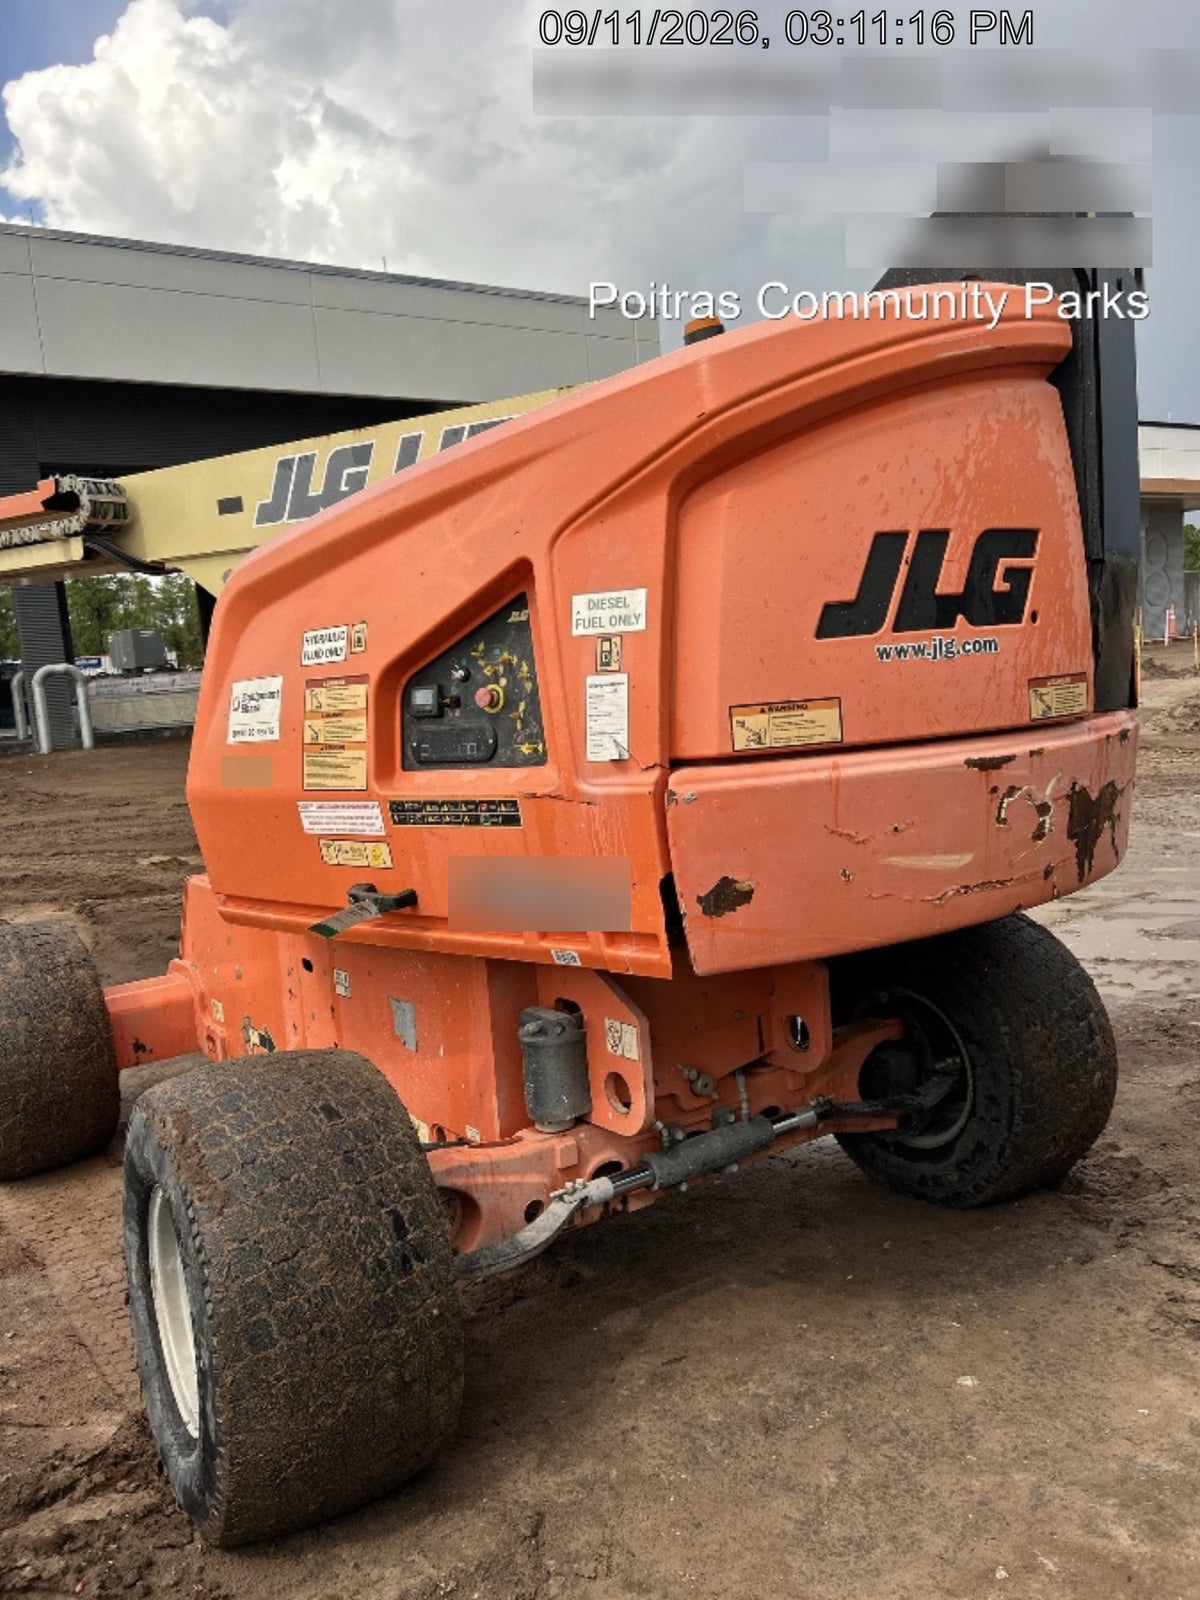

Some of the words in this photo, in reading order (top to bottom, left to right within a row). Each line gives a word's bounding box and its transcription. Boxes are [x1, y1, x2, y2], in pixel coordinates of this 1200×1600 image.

[253, 440, 376, 528] JLG
[815, 528, 1040, 640] JLG
[587, 596, 630, 611] DIESEL
[575, 616, 605, 630] FUEL
[609, 613, 641, 627] ONLY
[875, 637, 999, 661] www.jlg.com
